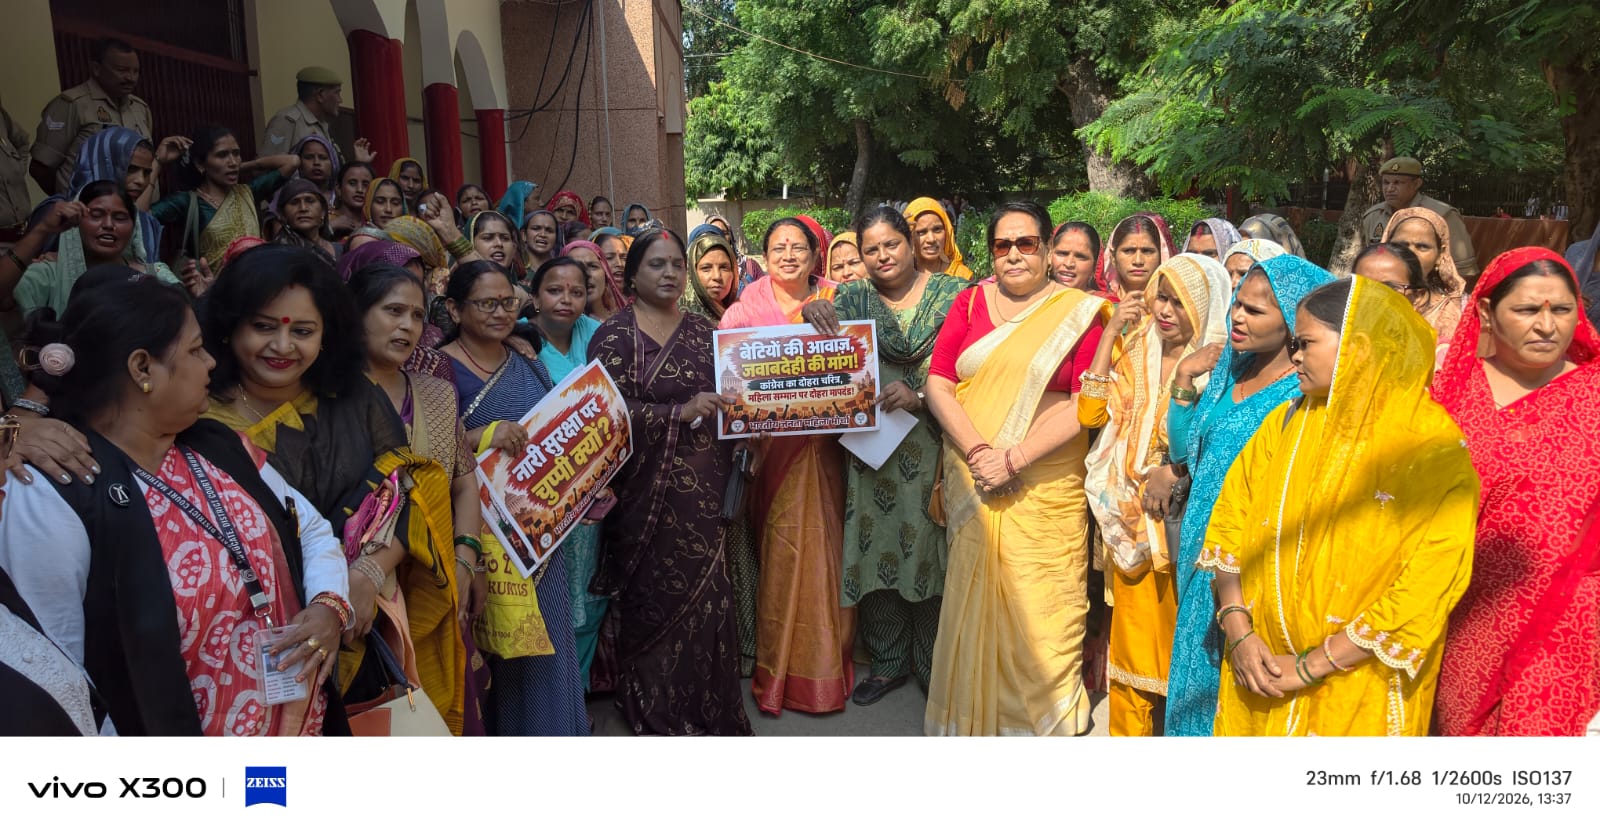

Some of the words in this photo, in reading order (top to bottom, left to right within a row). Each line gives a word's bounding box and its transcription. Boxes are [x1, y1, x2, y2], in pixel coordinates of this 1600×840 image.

[739, 341, 781, 360] बेटियों
[783, 338, 803, 356] की
[741, 355, 805, 378] जवाबदेही
[807, 355, 826, 372] की
[827, 352, 859, 370] मांग!
[759, 378, 784, 390] कांग्रेस
[785, 379, 797, 388] का
[798, 376, 819, 387] दोहरा
[820, 375, 843, 386] चरित्र,
[748, 391, 772, 402] महिला
[773, 391, 796, 401] सम्मान
[798, 391, 807, 400] पर
[809, 388, 828, 398] दोहरा
[829, 386, 855, 397] मापदंड!
[750, 419, 779, 431] भारतीय
[803, 416, 829, 427] महिला
[511, 443, 548, 482] नारी
[541, 410, 585, 457] सुरक्षा
[580, 397, 601, 419] पर
[135, 468, 167, 492] MATHURA
[200, 478, 217, 499] COURT
[530, 454, 576, 506] चुप्पी
[166, 489, 190, 509] COURT
[189, 508, 217, 534] DISTRICT
[211, 500, 230, 528] DISTRICT
[488, 581, 528, 597] KURTIS
